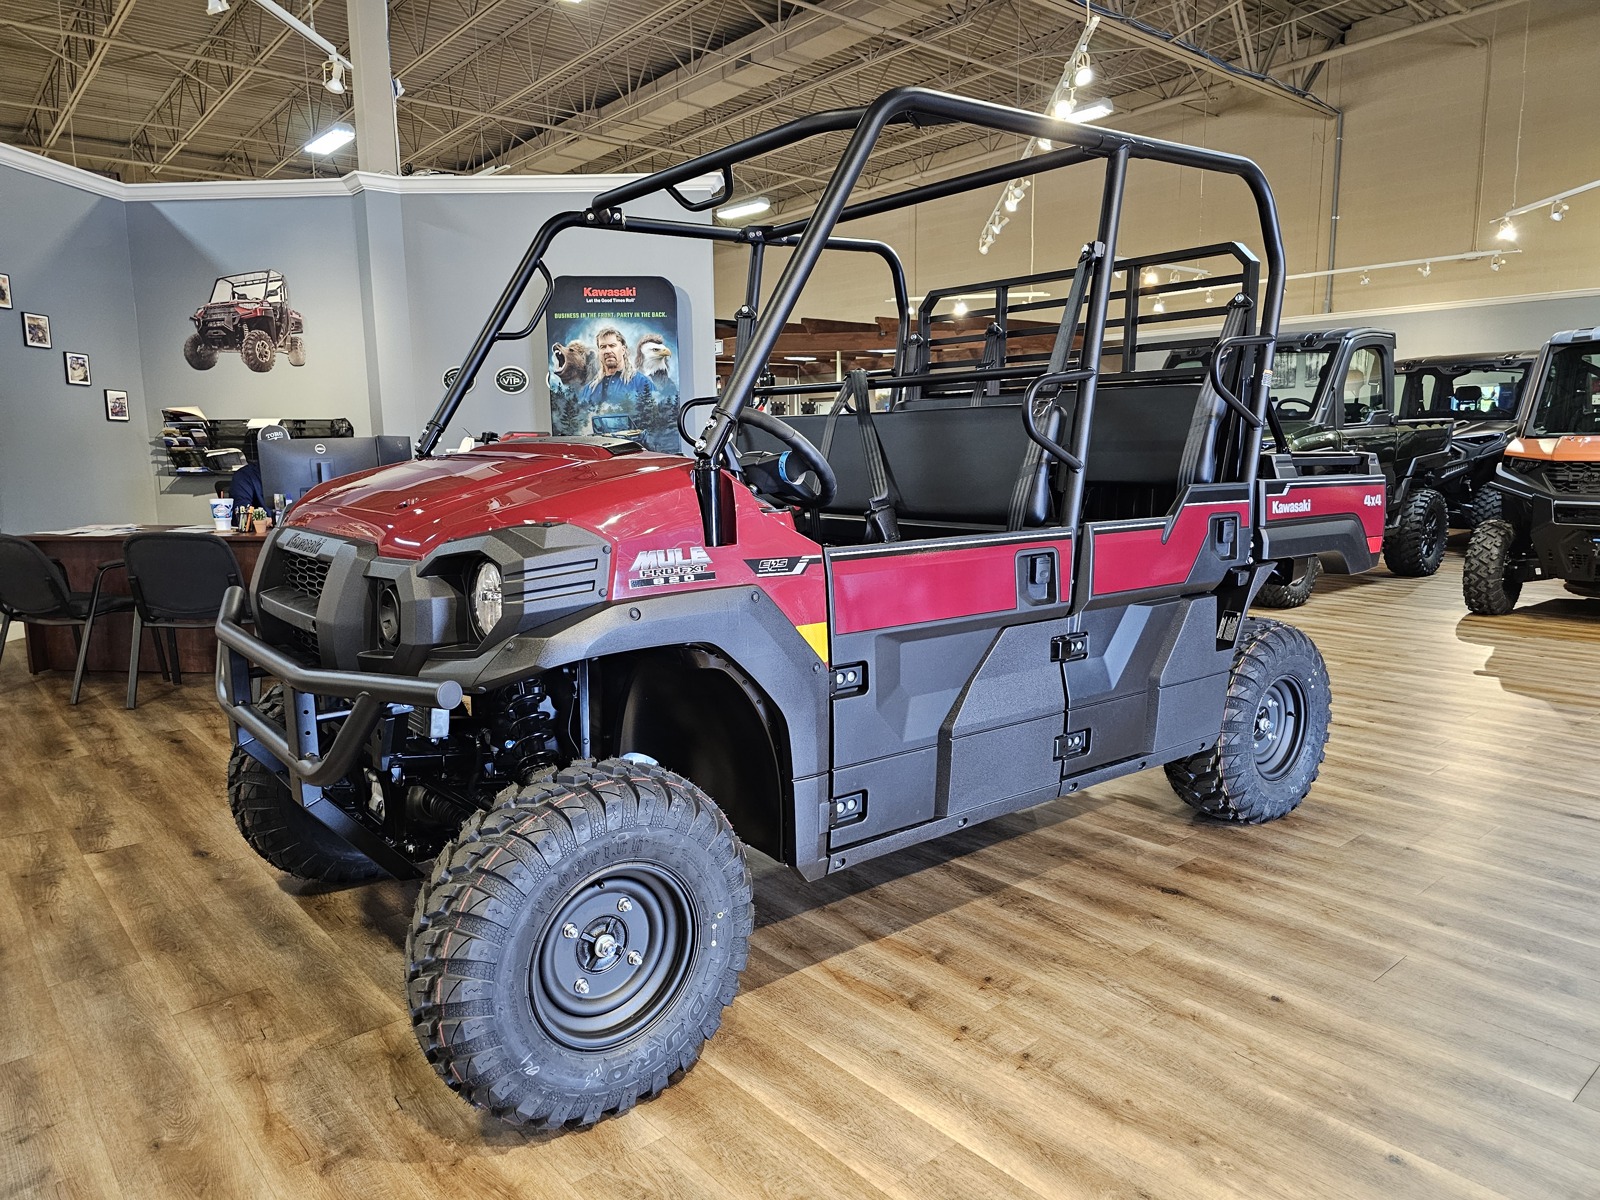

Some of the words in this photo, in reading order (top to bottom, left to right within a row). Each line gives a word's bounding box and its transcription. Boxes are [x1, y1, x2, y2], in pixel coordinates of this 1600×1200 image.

[583, 286, 636, 297] Kawasaki
[502, 377, 520, 385] VIP
[1272, 499, 1311, 514] Kawasaki
[1363, 494, 1382, 507] 4x4
[285, 532, 327, 555] Kawasaki
[629, 546, 713, 572] MULE
[758, 559, 788, 571] EPS
[653, 574, 695, 586] 820
